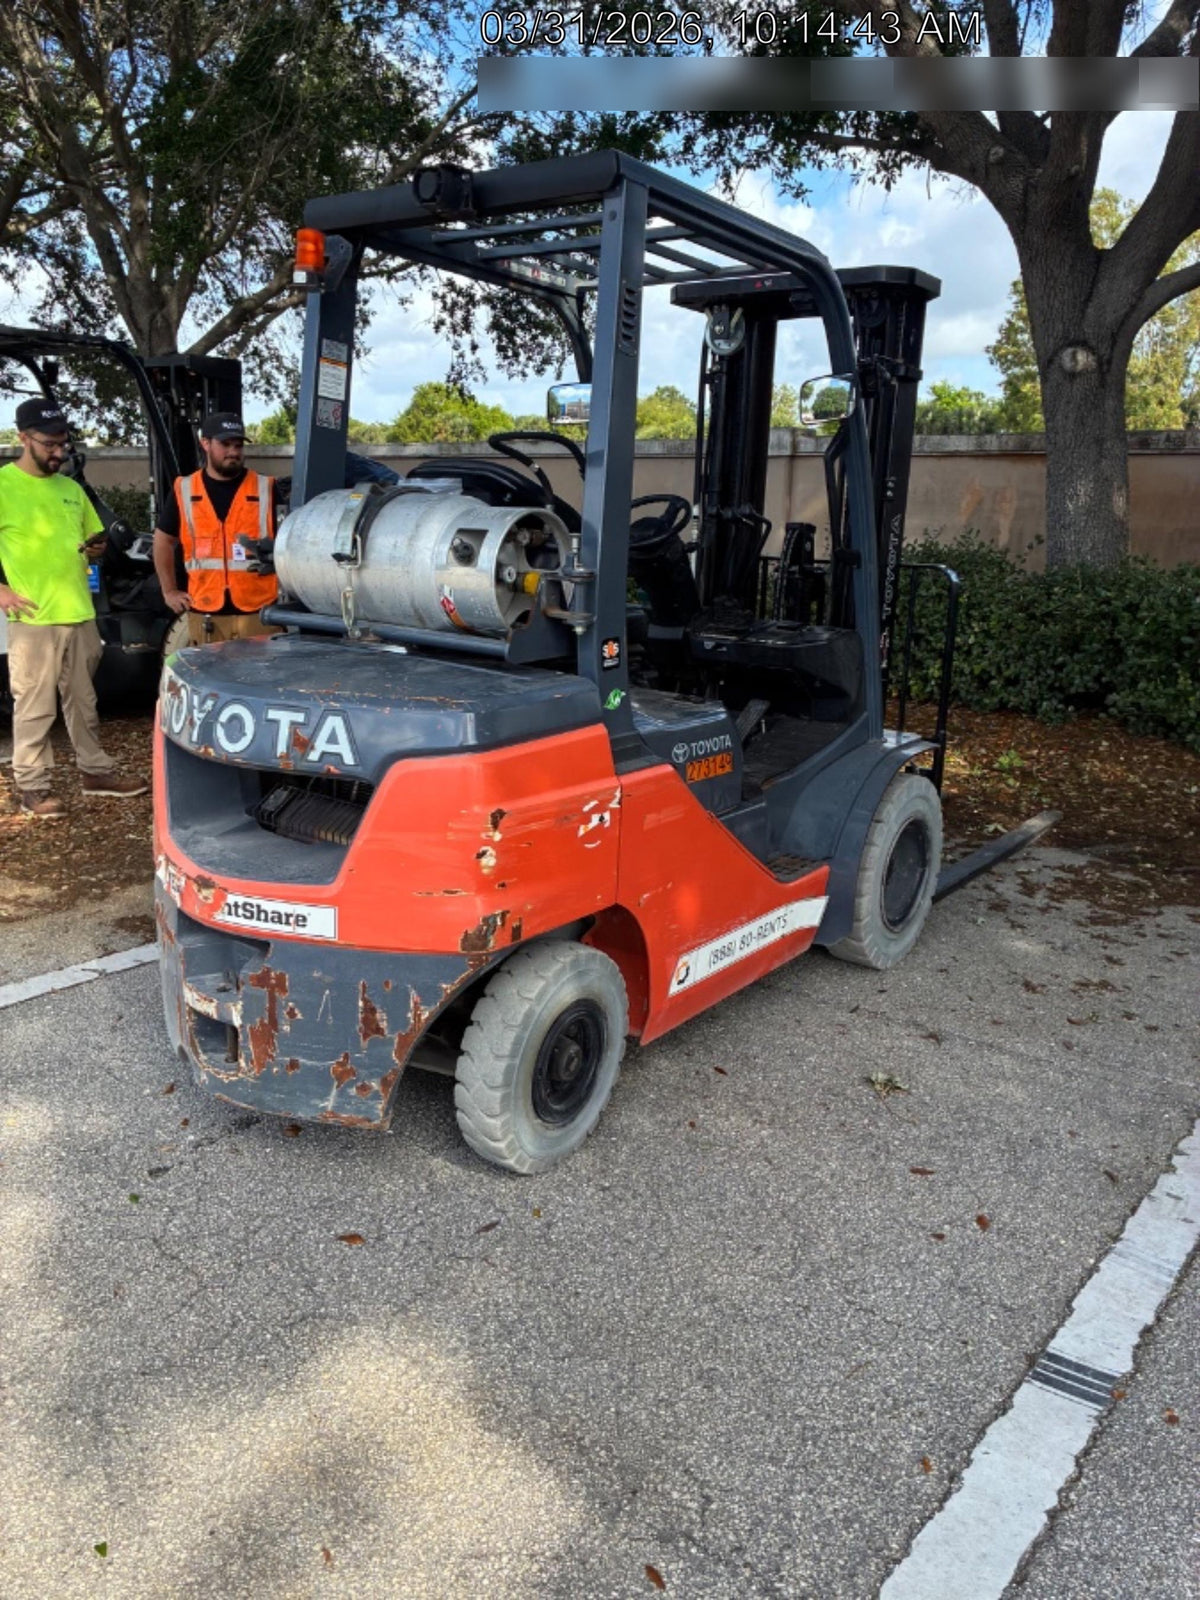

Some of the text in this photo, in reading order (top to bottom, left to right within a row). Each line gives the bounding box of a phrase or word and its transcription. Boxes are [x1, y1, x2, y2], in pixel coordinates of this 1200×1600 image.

[881, 513, 902, 620] TOYOTA
[690, 734, 732, 757] TOYOTA
[708, 913, 788, 969] (888) 80-RENTS
